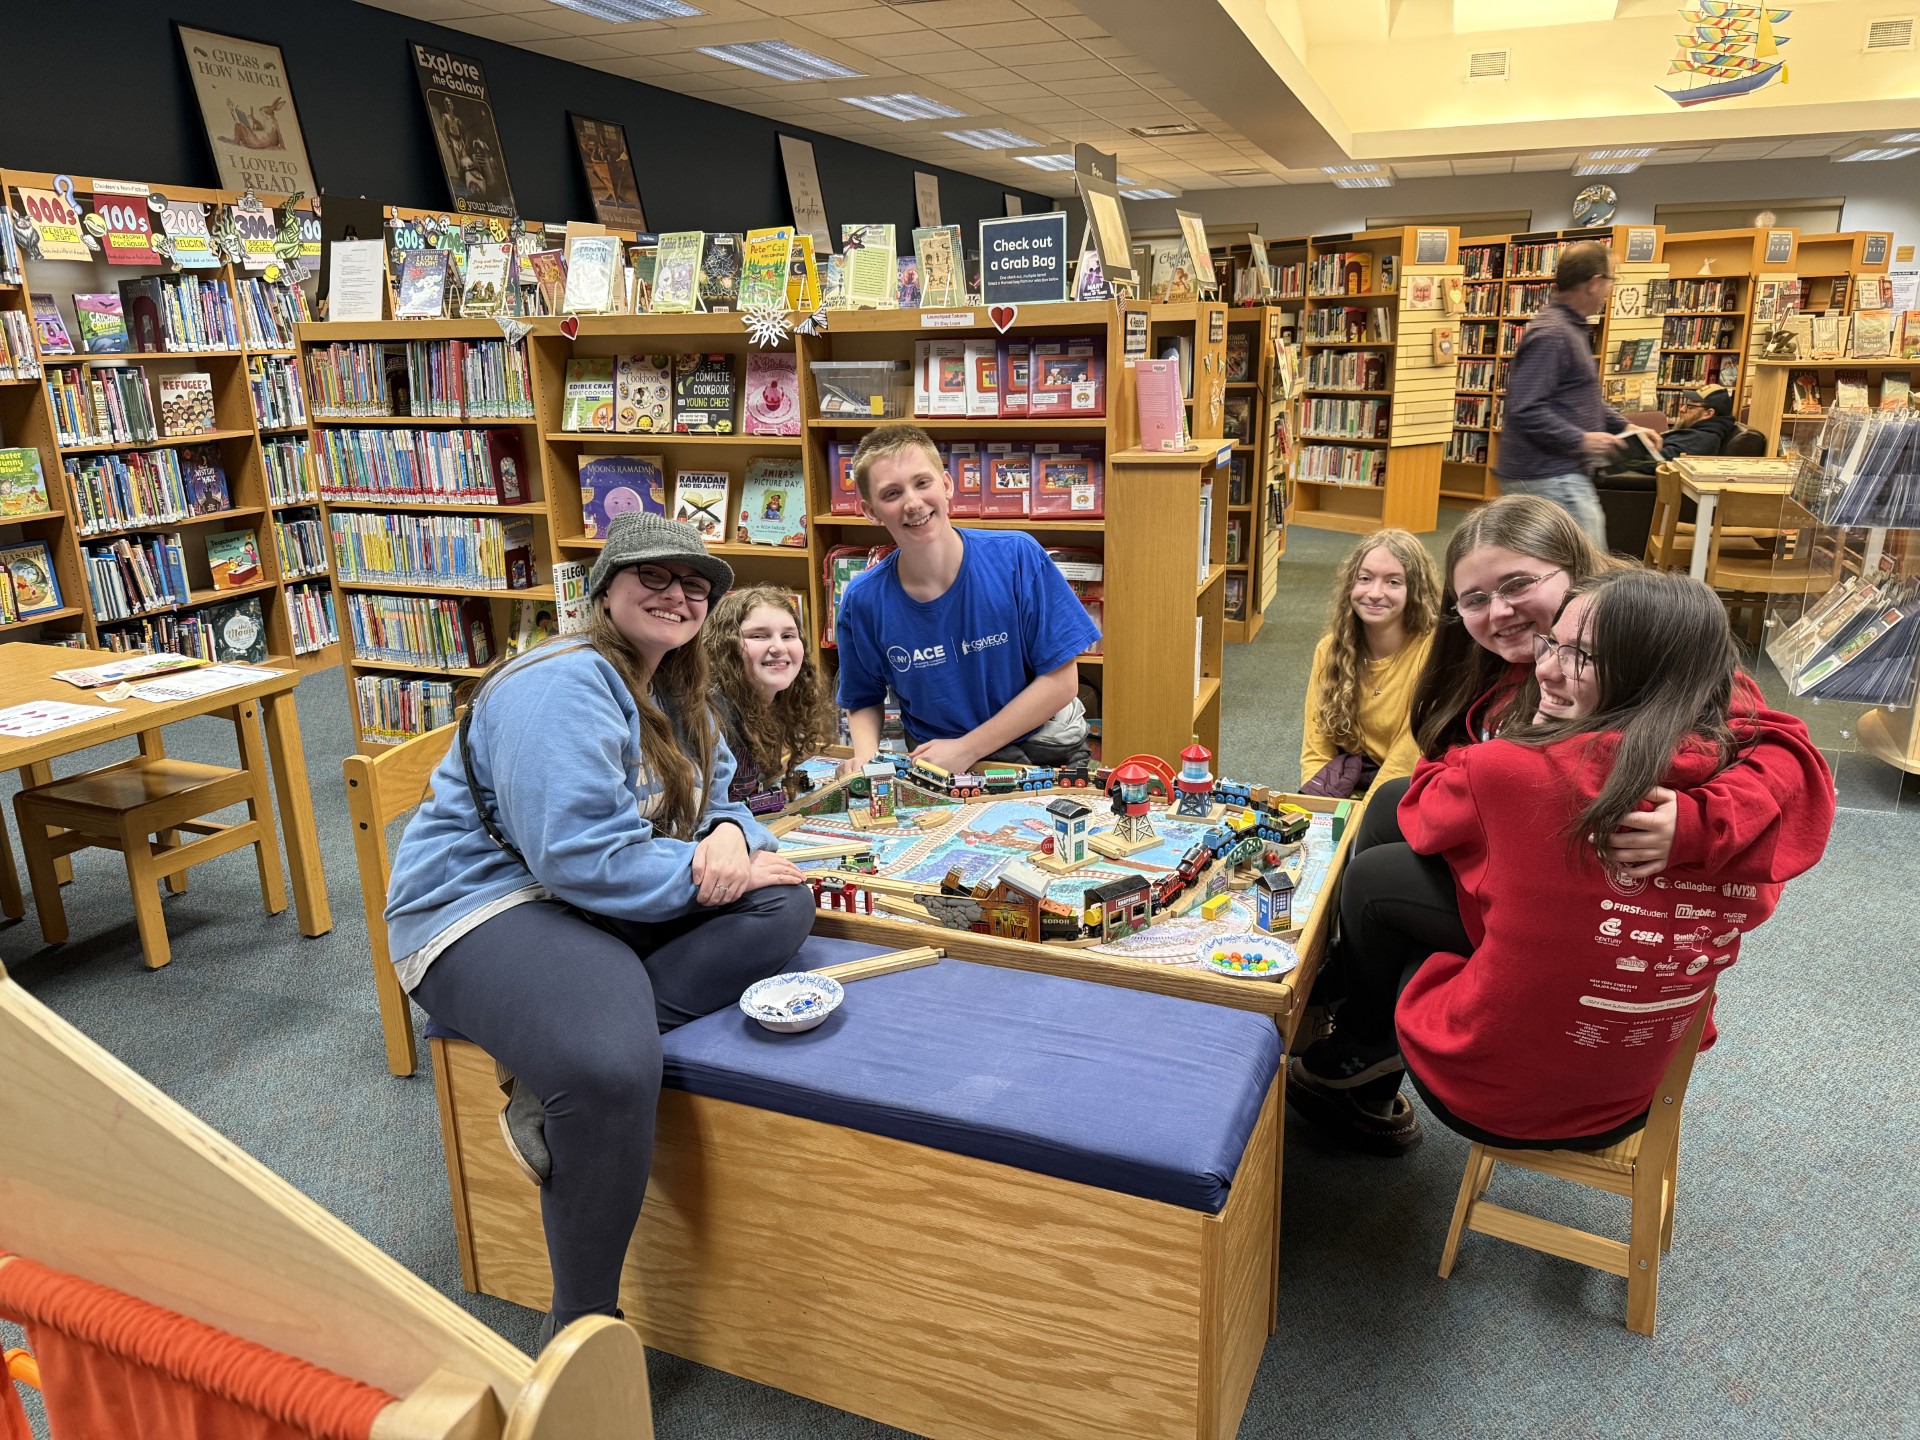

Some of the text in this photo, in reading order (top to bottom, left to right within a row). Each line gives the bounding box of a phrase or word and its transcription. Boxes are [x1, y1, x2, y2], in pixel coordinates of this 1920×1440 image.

[212, 48, 260, 70] GUESS
[414, 45, 480, 80] Explore
[198, 62, 282, 88] HOW MUCH
[432, 75, 485, 100] the Galaxy
[228, 154, 298, 175] I LOVE TO
[240, 171, 297, 193] READ
[26, 195, 77, 225] 000s
[467, 200, 486, 211] your
[486, 201, 513, 217] library
[98, 204, 149, 233] 100s
[162, 209, 206, 236] 200s
[42, 227, 77, 237] GENERAL
[234, 214, 275, 240] 300s
[53, 234, 72, 242] STUFF
[175, 238, 206, 249] RELIGION
[395, 229, 425, 250] 600s
[993, 235, 1053, 252] Check out
[247, 246, 275, 254] SCIENCES
[750, 244, 767, 254] Pete
[772, 243, 785, 252] Cat
[990, 255, 1056, 271] a Grab Bag
[1087, 283, 1104, 291] MARY
[626, 371, 662, 385] Cookbook
[695, 372, 730, 382] COMPLETE
[162, 379, 208, 391] REFUGEE?
[693, 384, 730, 395] COOKBOOK
[685, 397, 708, 408] YOUNG
[709, 398, 730, 408] CHEFS
[0, 452, 22, 460] aster
[587, 464, 655, 476] MOON'S RAMADAN
[761, 468, 795, 479] AMIRA'S
[679, 475, 727, 485] RAMADAN
[753, 478, 800, 488] PICTURE DAY
[210, 536, 240, 546] Teachers
[3, 550, 40, 564] EASTER
[566, 564, 586, 580] LEGO
[562, 576, 590, 601] IDEA
[970, 632, 1009, 650] OSWEGO
[913, 644, 946, 662] ACE
[1674, 880, 1717, 893] Gallagher
[1594, 935, 1623, 945] CENTURY
[1629, 929, 1665, 944] CSEA
